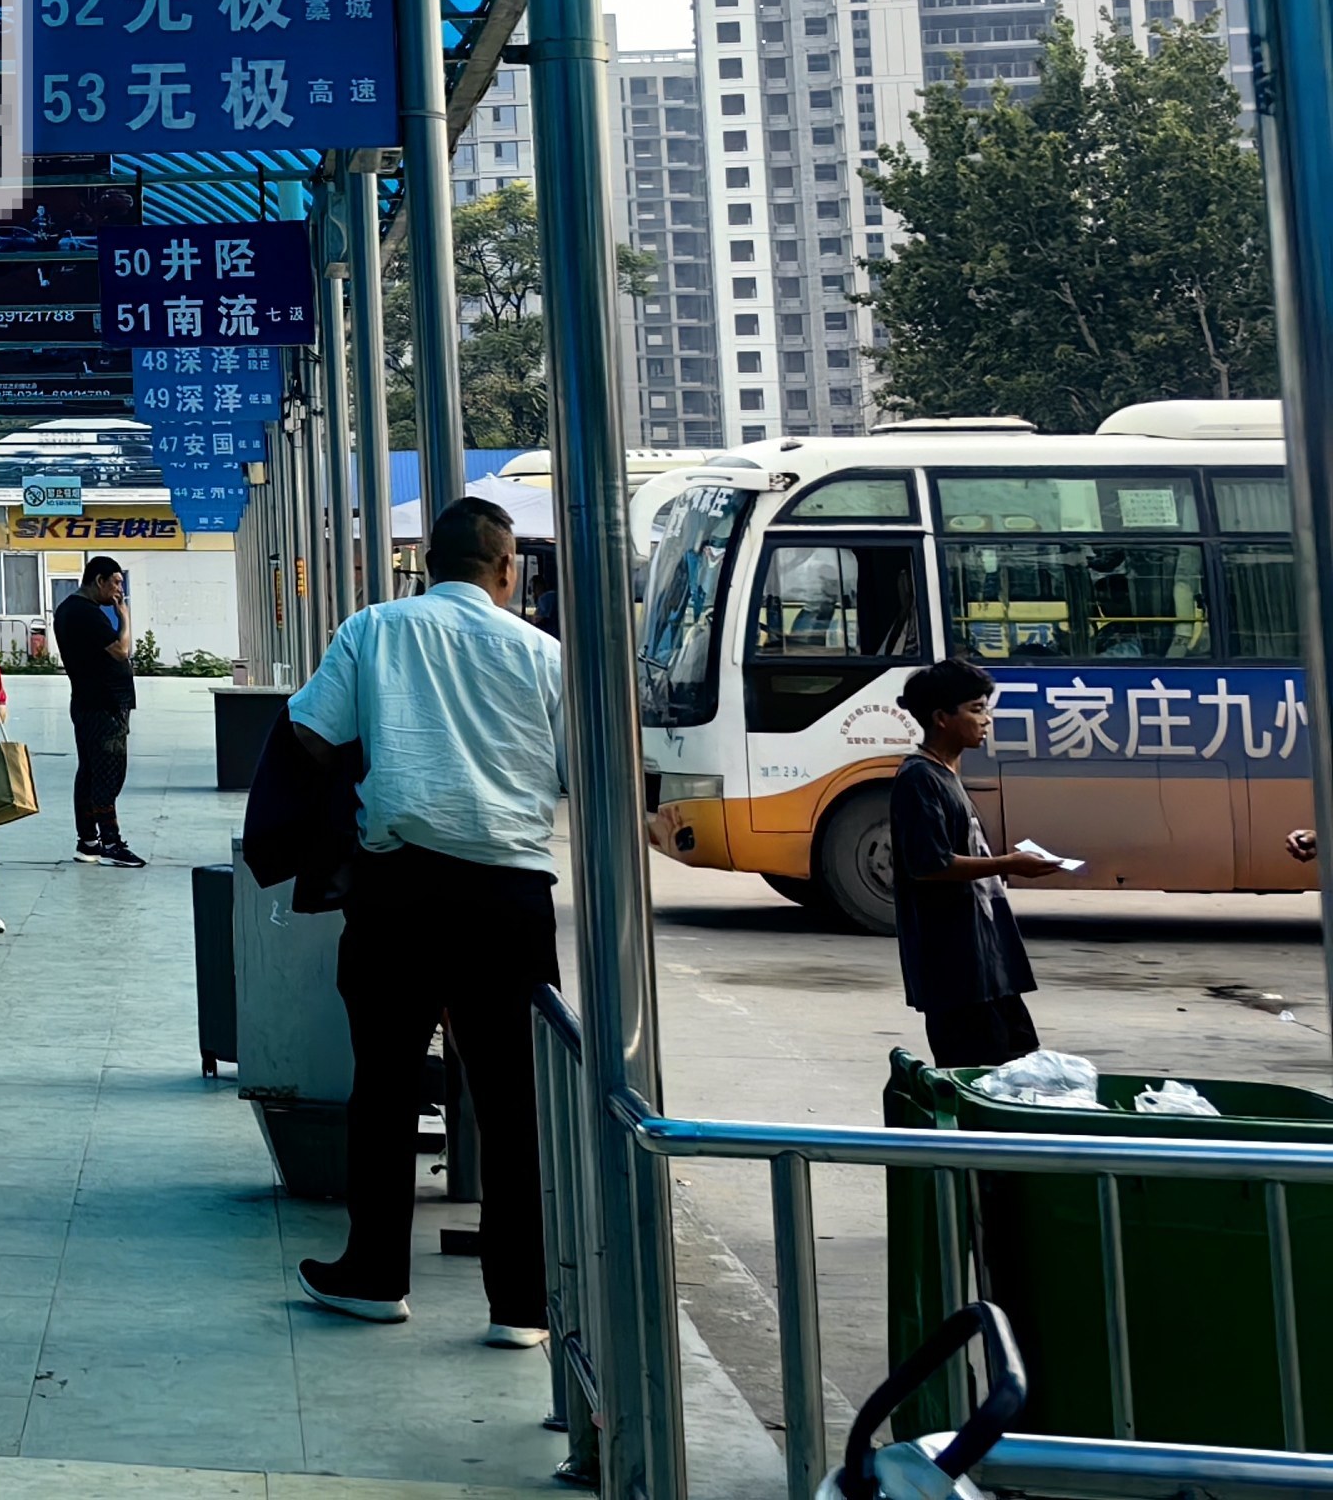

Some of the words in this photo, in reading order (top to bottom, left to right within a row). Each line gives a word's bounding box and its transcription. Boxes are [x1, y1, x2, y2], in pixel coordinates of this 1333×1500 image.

[43, 73, 106, 124] 53
[125, 57, 295, 132] 无极
[308, 77, 377, 105] 高速
[114, 249, 150, 277] 50
[160, 238, 256, 282] 井陉
[117, 303, 151, 332] 51
[163, 294, 260, 337] 南流
[142, 350, 168, 371] 48
[144, 388, 170, 408] 49
[176, 384, 242, 413] 深泽
[159, 436, 178, 452] 47
[184, 433, 234, 456] 安国
